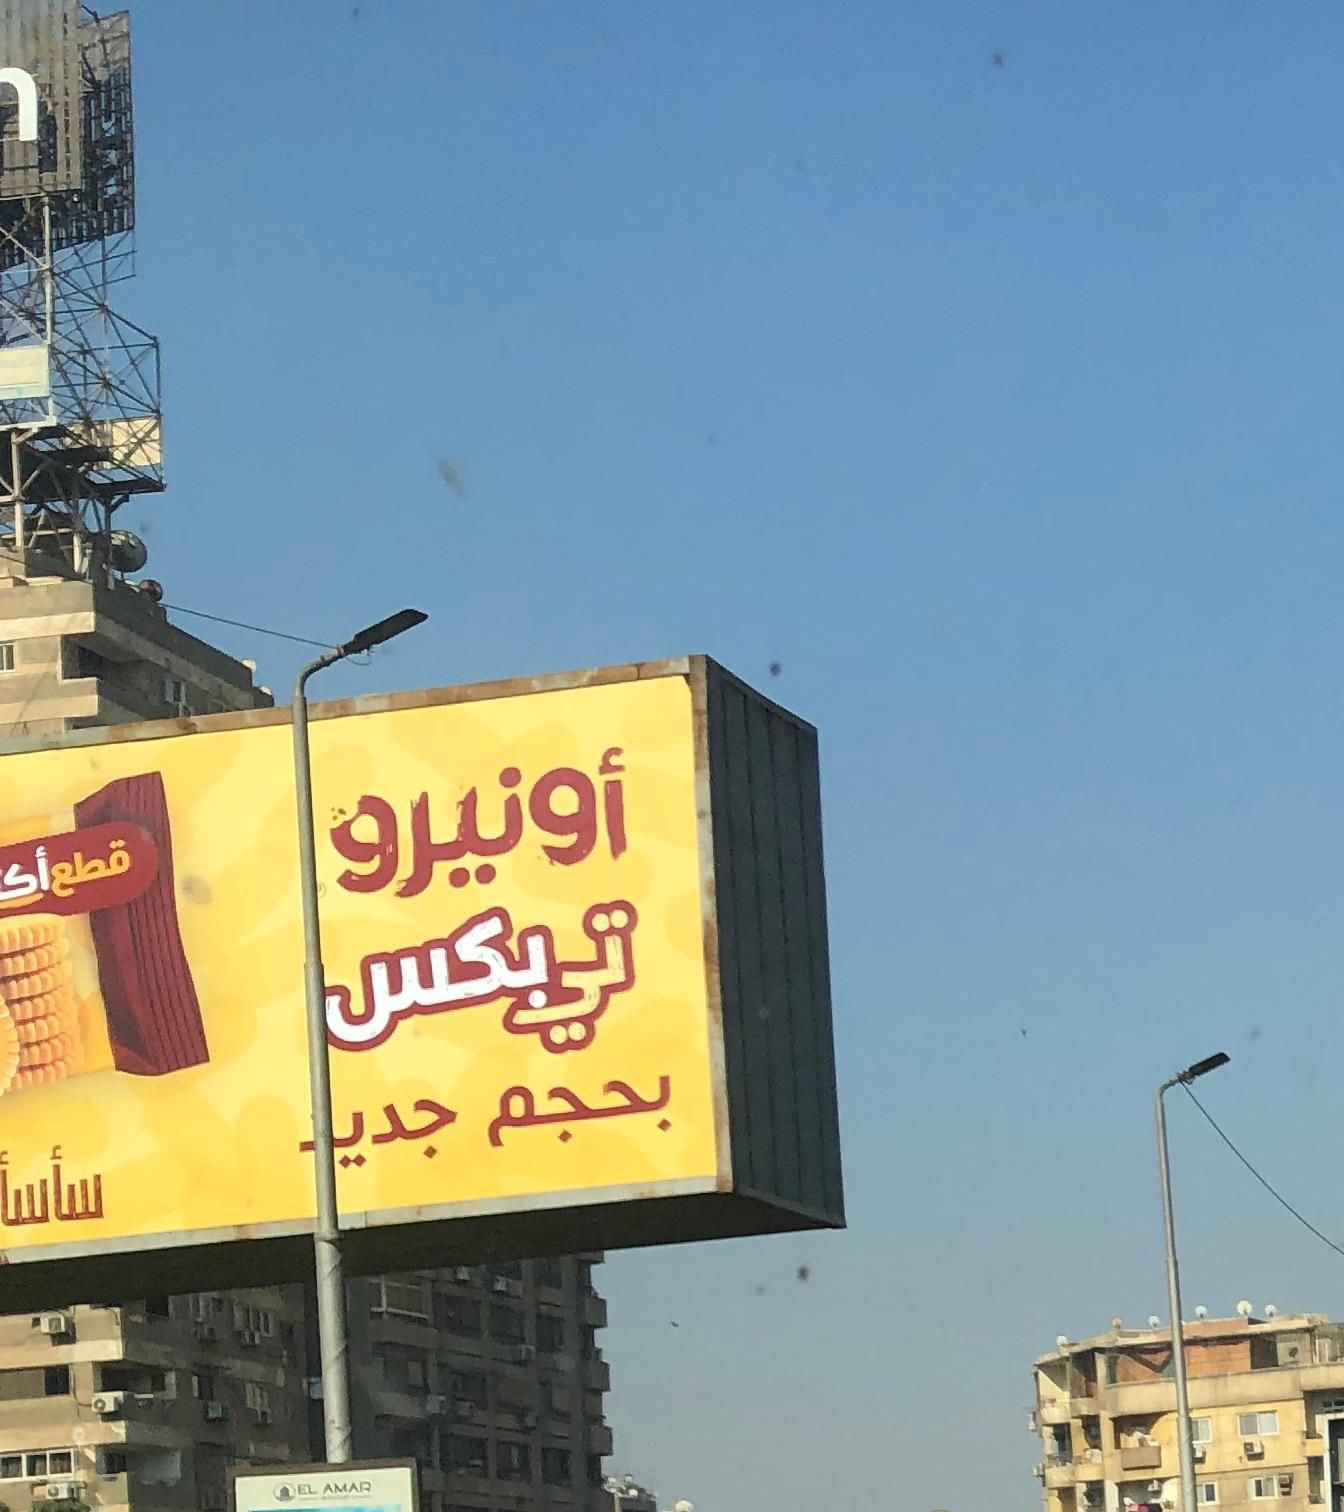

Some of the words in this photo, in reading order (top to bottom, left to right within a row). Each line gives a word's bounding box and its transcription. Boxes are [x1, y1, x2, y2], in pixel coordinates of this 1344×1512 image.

[331, 747, 627, 896] أونيرو
[51, 839, 130, 897] قطع
[488, 1073, 671, 1147] بحجم
[297, 1484, 318, 1494] EL
[323, 1481, 371, 1494] AMAR
